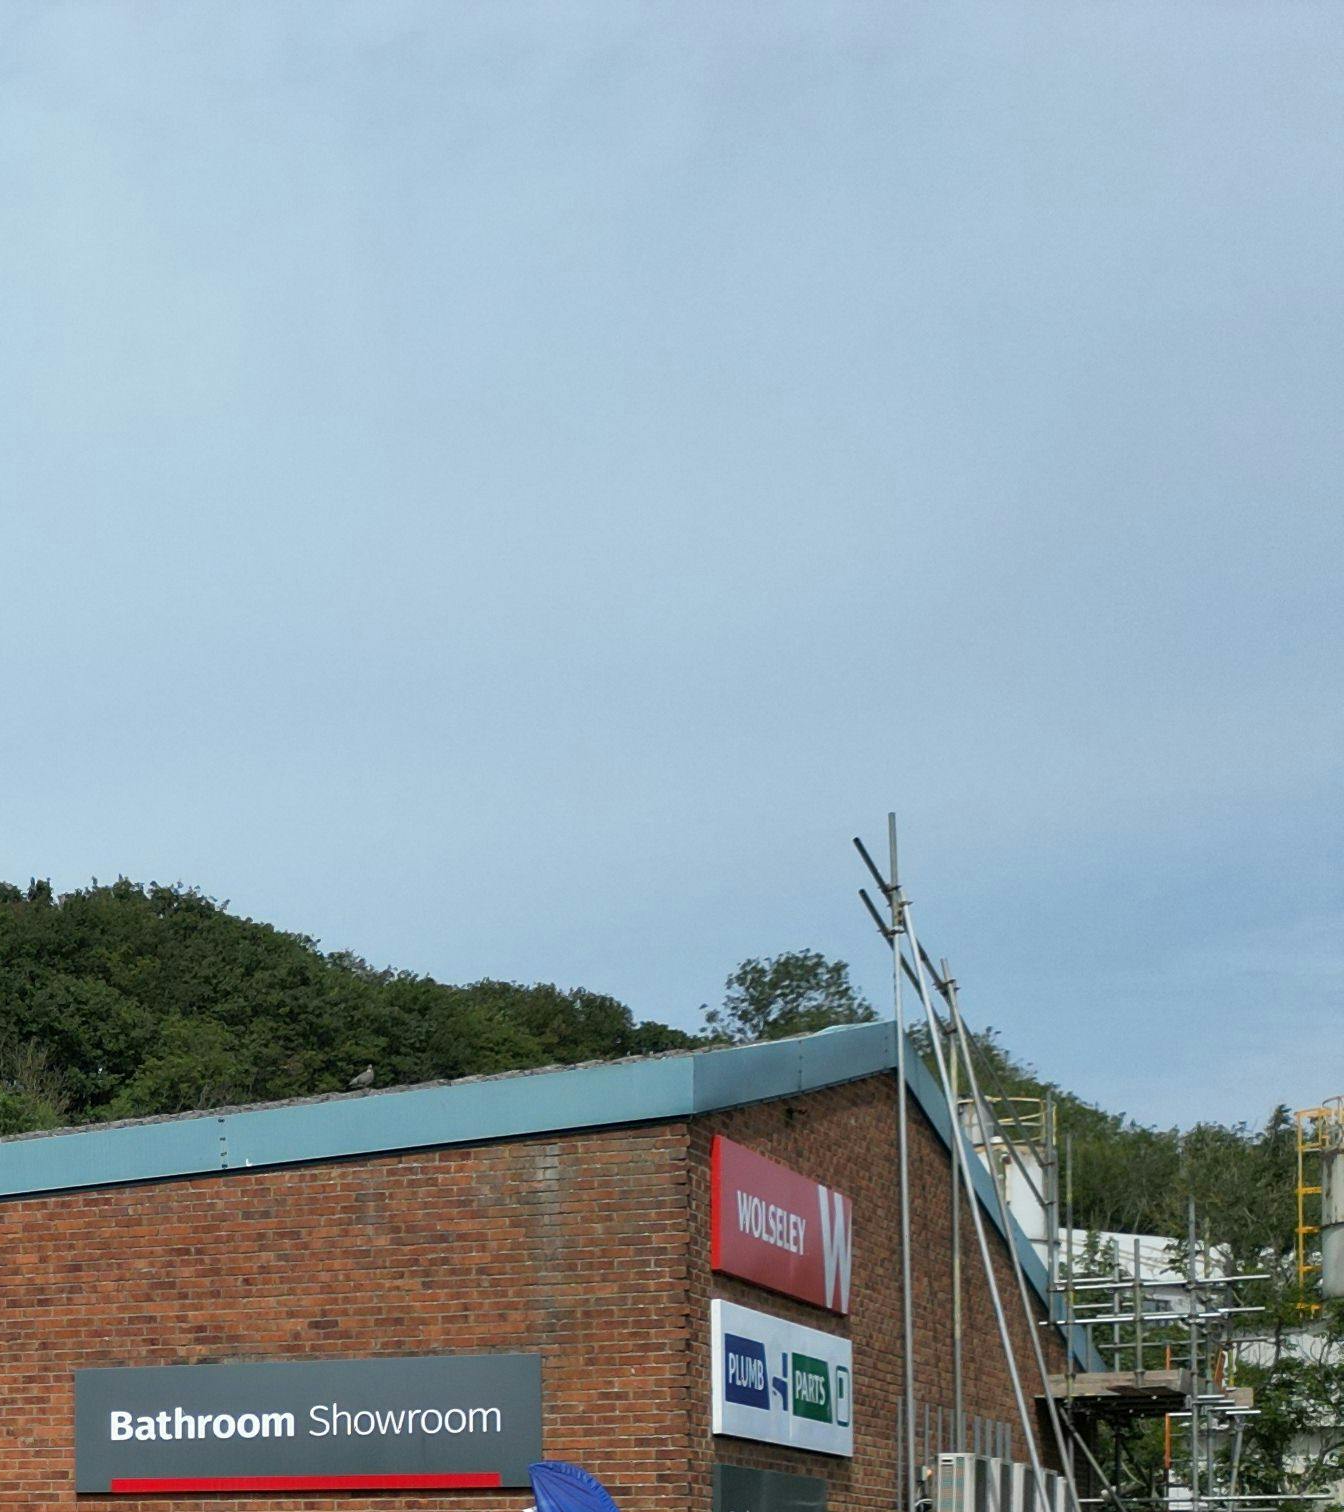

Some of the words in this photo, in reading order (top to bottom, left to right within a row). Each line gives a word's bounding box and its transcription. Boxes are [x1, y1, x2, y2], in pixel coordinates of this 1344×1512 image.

[737, 1190, 806, 1255] WOLSELEY
[818, 1184, 852, 1314] W
[728, 1352, 765, 1391] PLUMB
[795, 1370, 826, 1405] PARTS
[110, 1406, 295, 1441] Bathroom
[308, 1403, 502, 1437] Showroom
